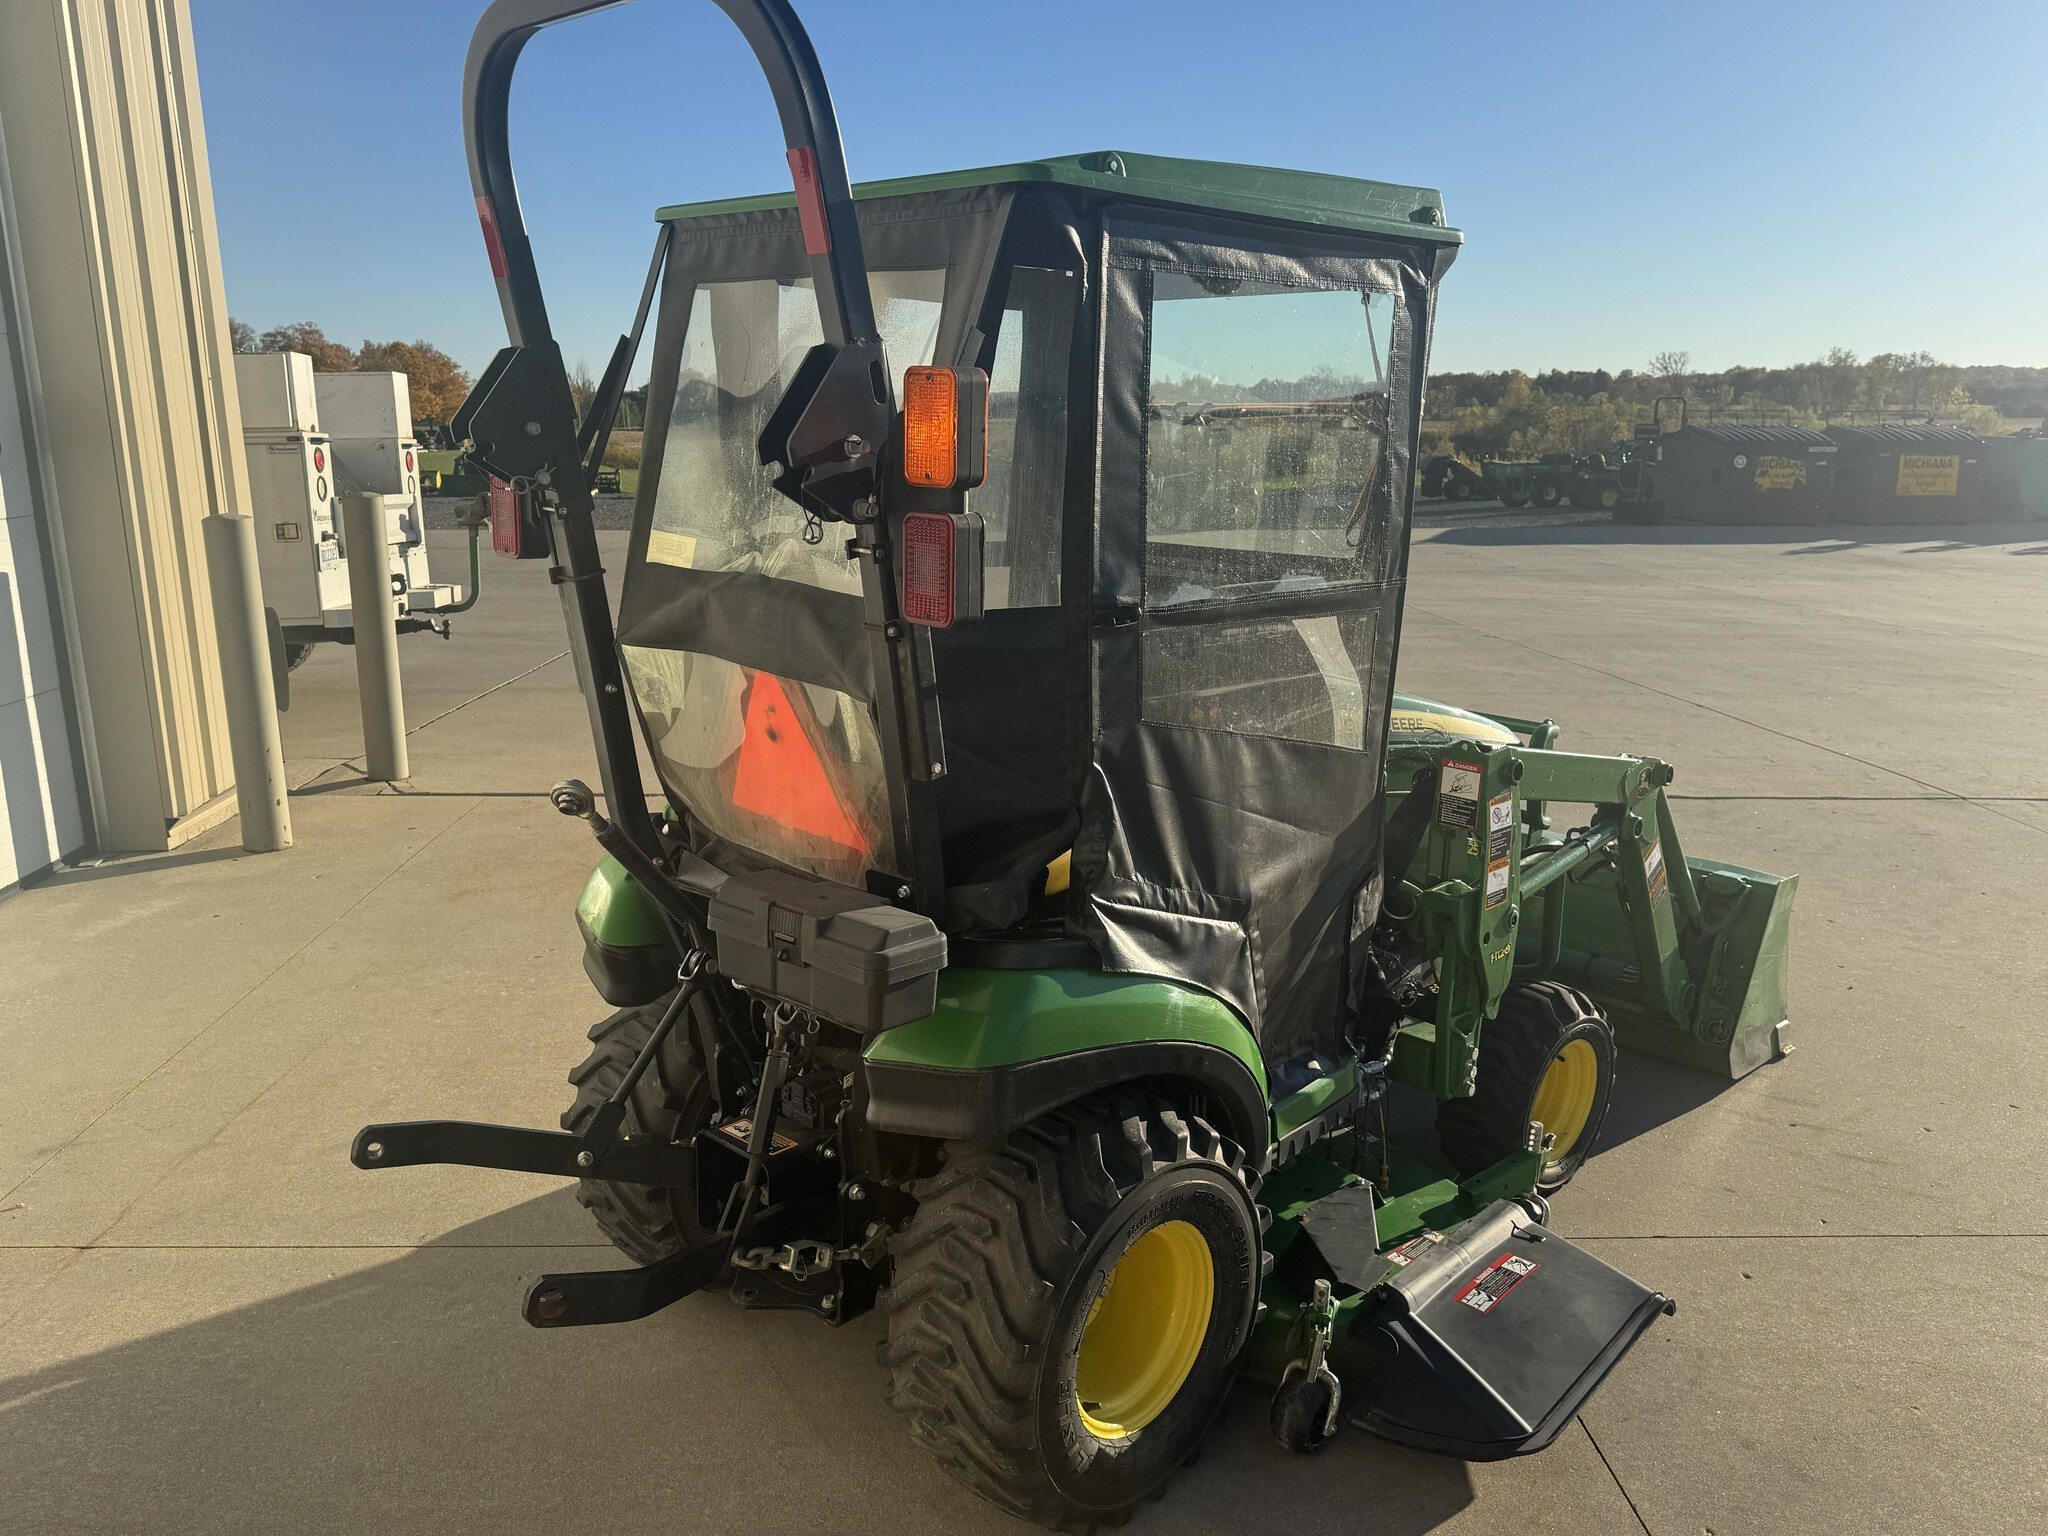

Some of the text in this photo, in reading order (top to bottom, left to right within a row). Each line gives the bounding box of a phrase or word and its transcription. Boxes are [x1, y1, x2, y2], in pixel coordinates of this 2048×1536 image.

[1903, 457, 1953, 470] MICHIANA
[1391, 717, 1423, 731] EERE
[1455, 763, 1478, 773] DANGER
[1195, 1189, 1234, 1220] TRAC
[1059, 1379, 1092, 1475] LISLE
